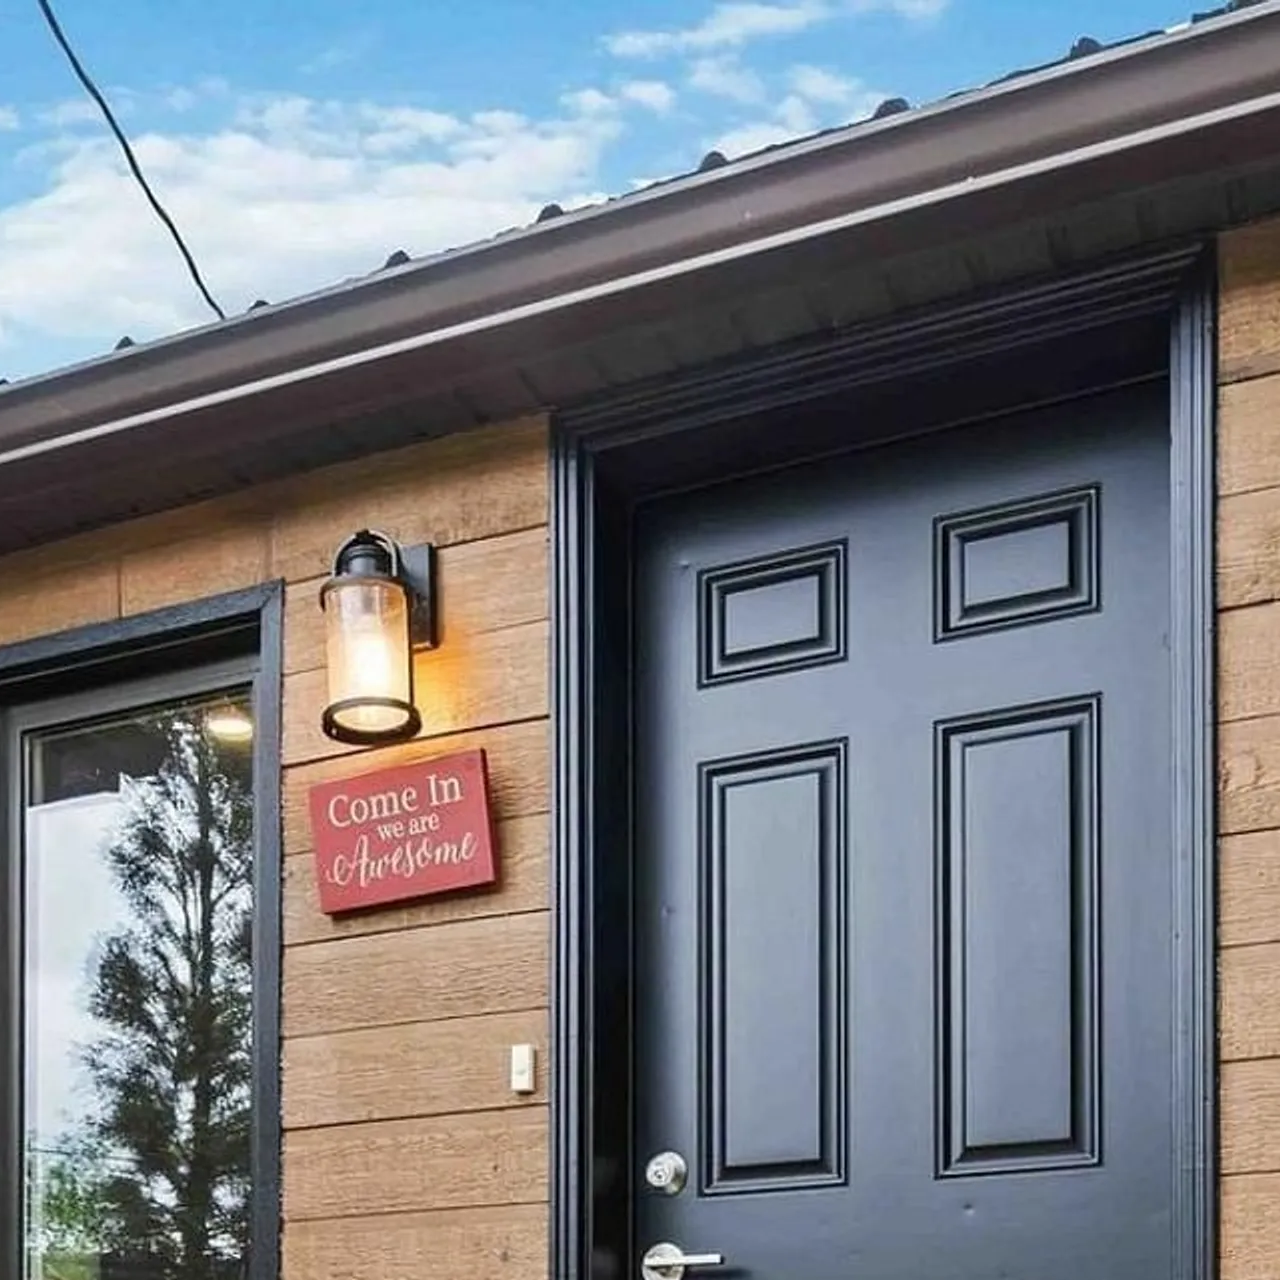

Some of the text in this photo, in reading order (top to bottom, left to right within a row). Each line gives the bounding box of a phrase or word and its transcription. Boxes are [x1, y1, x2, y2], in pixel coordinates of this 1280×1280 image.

[328, 774, 464, 827] Come In
[377, 812, 440, 840] we are
[325, 832, 477, 888] Awesome
